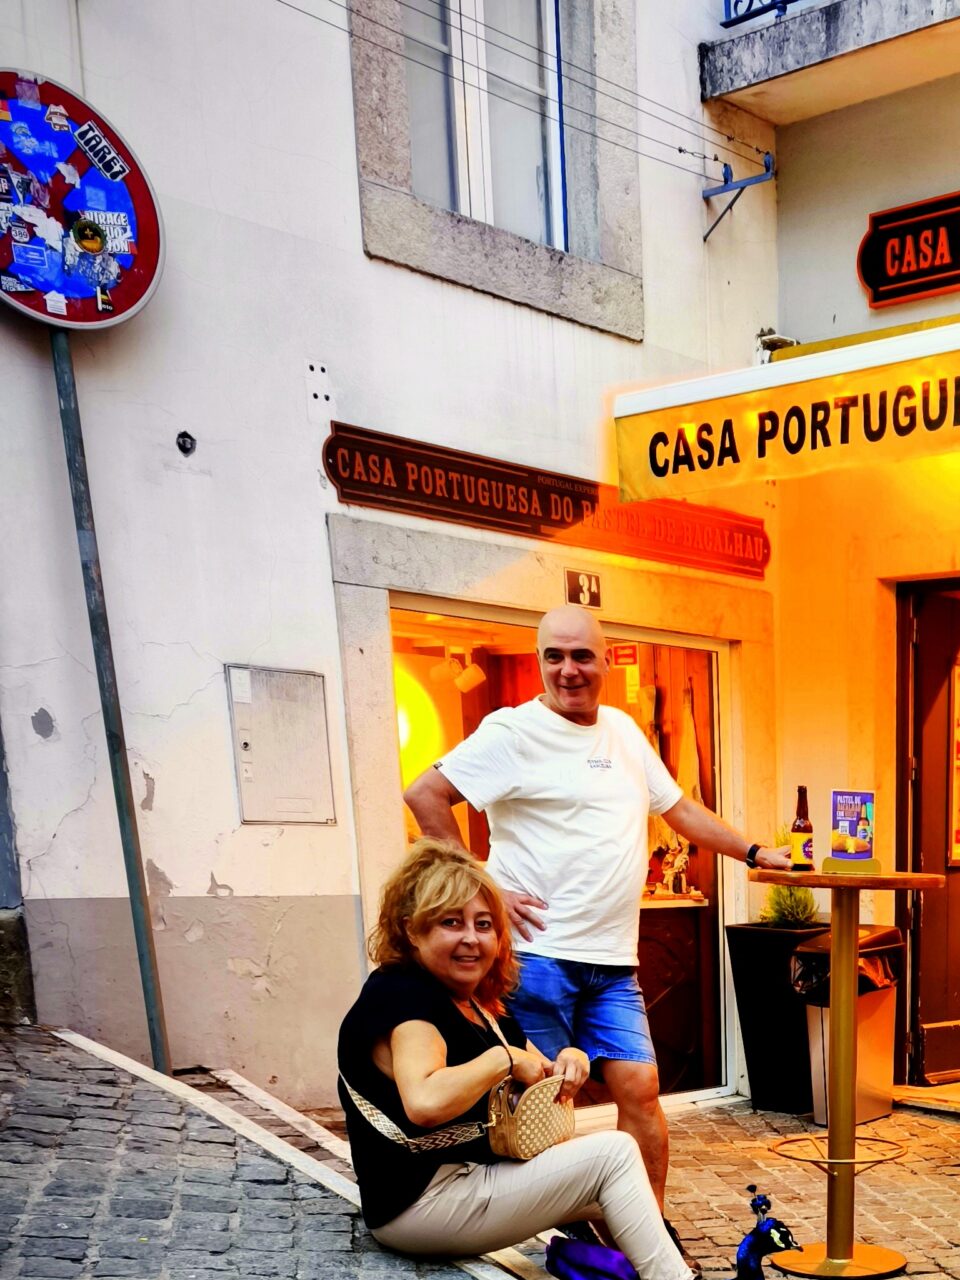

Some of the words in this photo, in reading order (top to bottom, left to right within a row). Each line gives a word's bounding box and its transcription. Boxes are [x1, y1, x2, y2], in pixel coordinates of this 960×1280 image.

[886, 234, 951, 278] CASA
[649, 419, 740, 478] CASA
[337, 447, 397, 488] CASA
[406, 462, 542, 517] PORTUGUESA
[551, 494, 574, 523] DO
[581, 500, 649, 538] PASTEL
[655, 517, 677, 544] DE
[683, 522, 763, 562] BACALHAU
[537, 475, 573, 491] PORTUGAL
